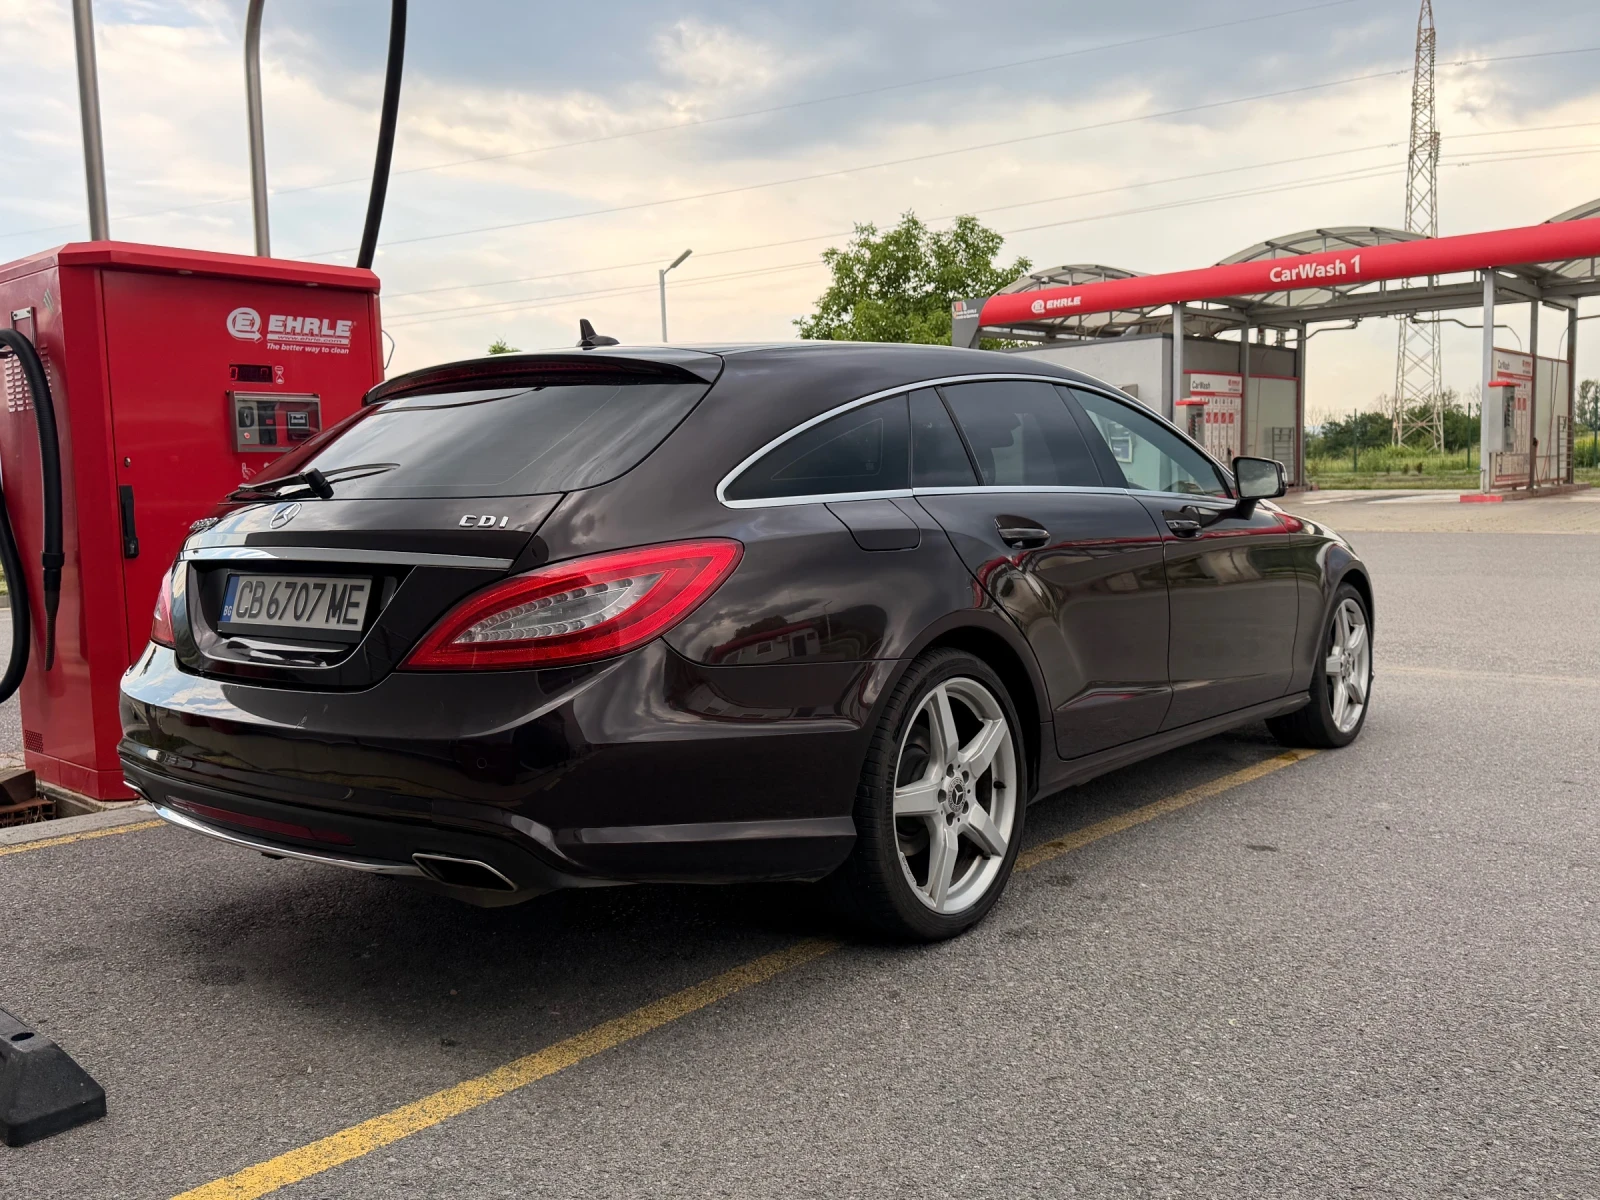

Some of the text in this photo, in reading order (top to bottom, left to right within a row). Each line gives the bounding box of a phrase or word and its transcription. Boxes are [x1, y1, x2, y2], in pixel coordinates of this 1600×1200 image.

[1269, 255, 1361, 282] CarWash 1
[1045, 296, 1082, 309] EHRLE
[268, 314, 352, 337] EHRLE
[281, 344, 304, 352] better
[305, 346, 320, 354] way
[459, 514, 509, 528] CDI
[236, 580, 365, 625] CB 6707 ME
[223, 605, 233, 616] BG
